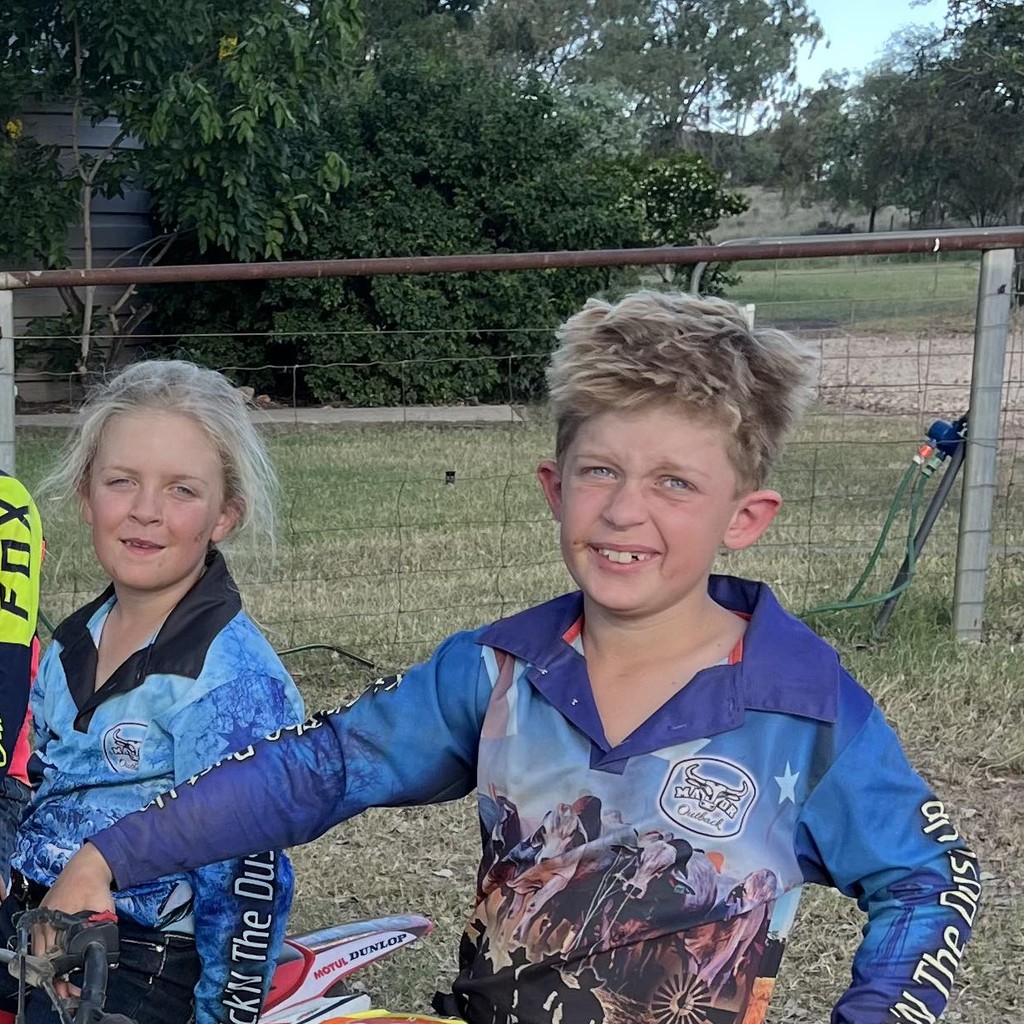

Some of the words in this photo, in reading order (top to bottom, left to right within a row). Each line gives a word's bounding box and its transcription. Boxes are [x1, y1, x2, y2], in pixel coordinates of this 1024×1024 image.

[677, 803, 725, 831] Outback
[232, 910, 272, 962] The
[313, 957, 348, 980] MOTUL
[348, 933, 407, 960] DUNLOP
[913, 925, 965, 1000] The
